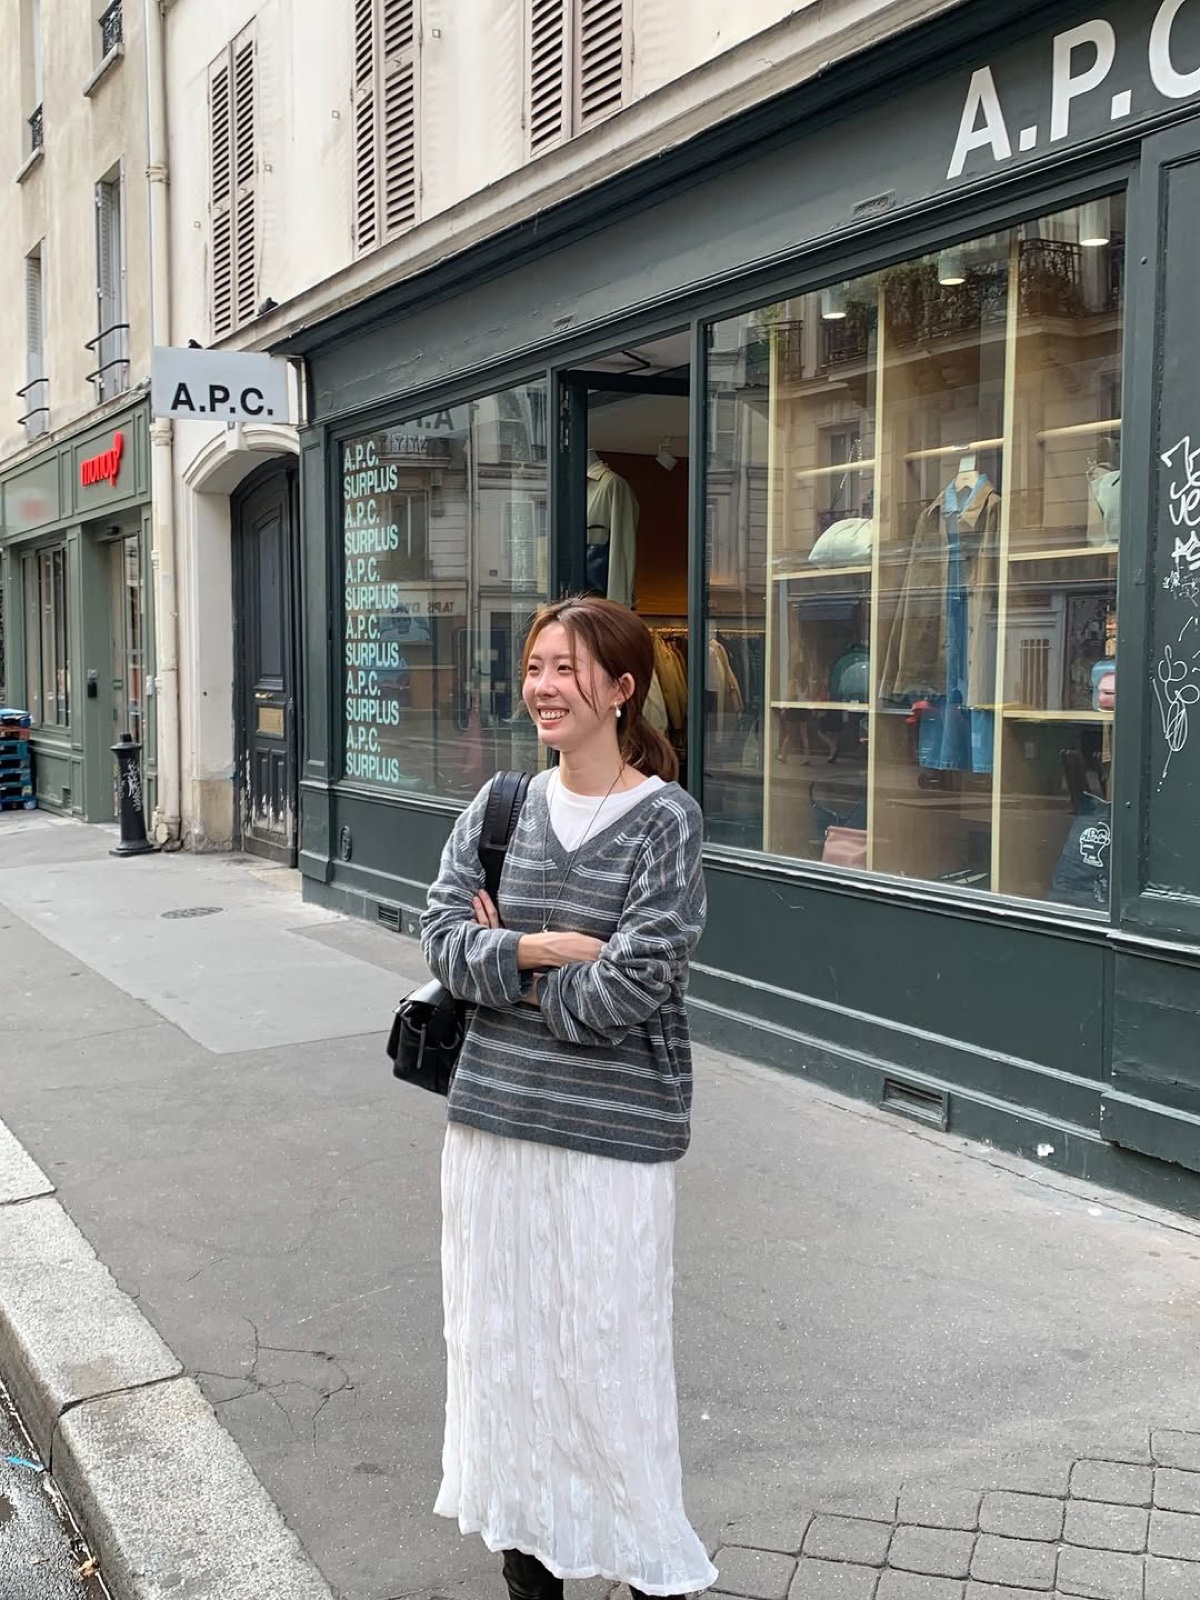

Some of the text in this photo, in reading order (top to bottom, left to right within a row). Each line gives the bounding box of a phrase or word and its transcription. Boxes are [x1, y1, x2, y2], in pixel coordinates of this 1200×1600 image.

[171, 382, 274, 416] A.P.C.
[343, 440, 379, 472] A.P.C.
[343, 464, 398, 500] SURPLUS
[344, 498, 380, 529] A.P.C.
[344, 524, 399, 556] SURPLUS
[345, 556, 380, 584] A.P.C.
[345, 583, 399, 610] SURPLUS
[345, 614, 381, 640] A.P.C.
[345, 642, 399, 668] SURPLUS
[345, 670, 381, 696] A.P.C.
[346, 697, 399, 726] SURPLUS
[346, 725, 381, 752] A.P.C.
[346, 751, 399, 783] SURPLUS
